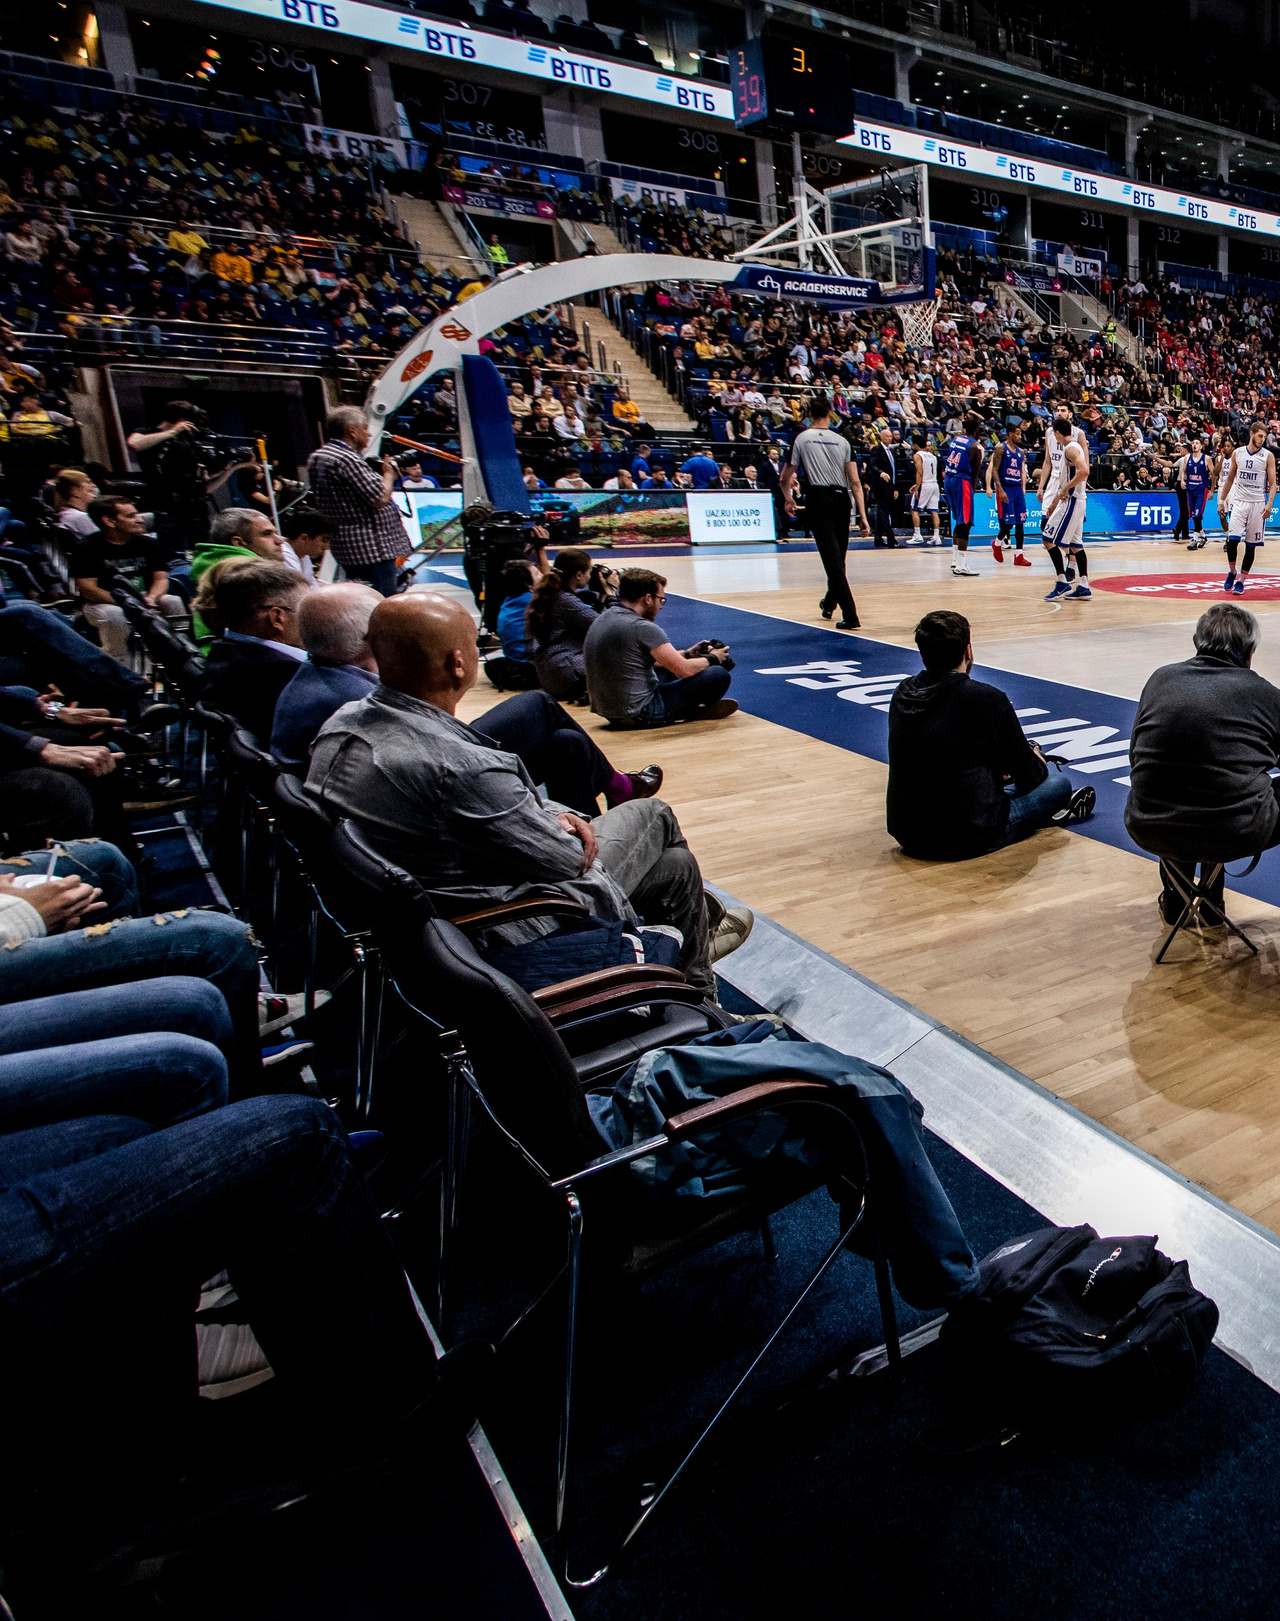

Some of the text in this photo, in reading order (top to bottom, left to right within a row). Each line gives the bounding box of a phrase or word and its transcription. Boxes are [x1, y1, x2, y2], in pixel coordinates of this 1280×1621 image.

[424, 28, 476, 58] ВТБ
[443, 79, 492, 108] 307
[676, 86, 715, 112] ВТБ
[678, 127, 719, 152] 308
[860, 130, 891, 151] ВТБ
[806, 153, 841, 176] 309
[938, 147, 966, 167] ВТБ
[1009, 163, 1035, 182] ВТБ
[1073, 177, 1097, 195] ВТБ
[970, 188, 1000, 208] 310
[1133, 190, 1155, 208] ВТБ
[1080, 211, 1104, 229] 311
[1187, 203, 1208, 219] ВТБ
[1237, 214, 1256, 229] ВТБ
[1158, 227, 1181, 244] 312
[1262, 247, 1280, 263] 313
[946, 450, 961, 468] 44
[1245, 459, 1253, 469] 13
[1239, 470, 1258, 481] ZENIT
[1141, 506, 1172, 525] ВТБ
[1255, 531, 1262, 541] 13
[1081, 1247, 1122, 1299] Champion
